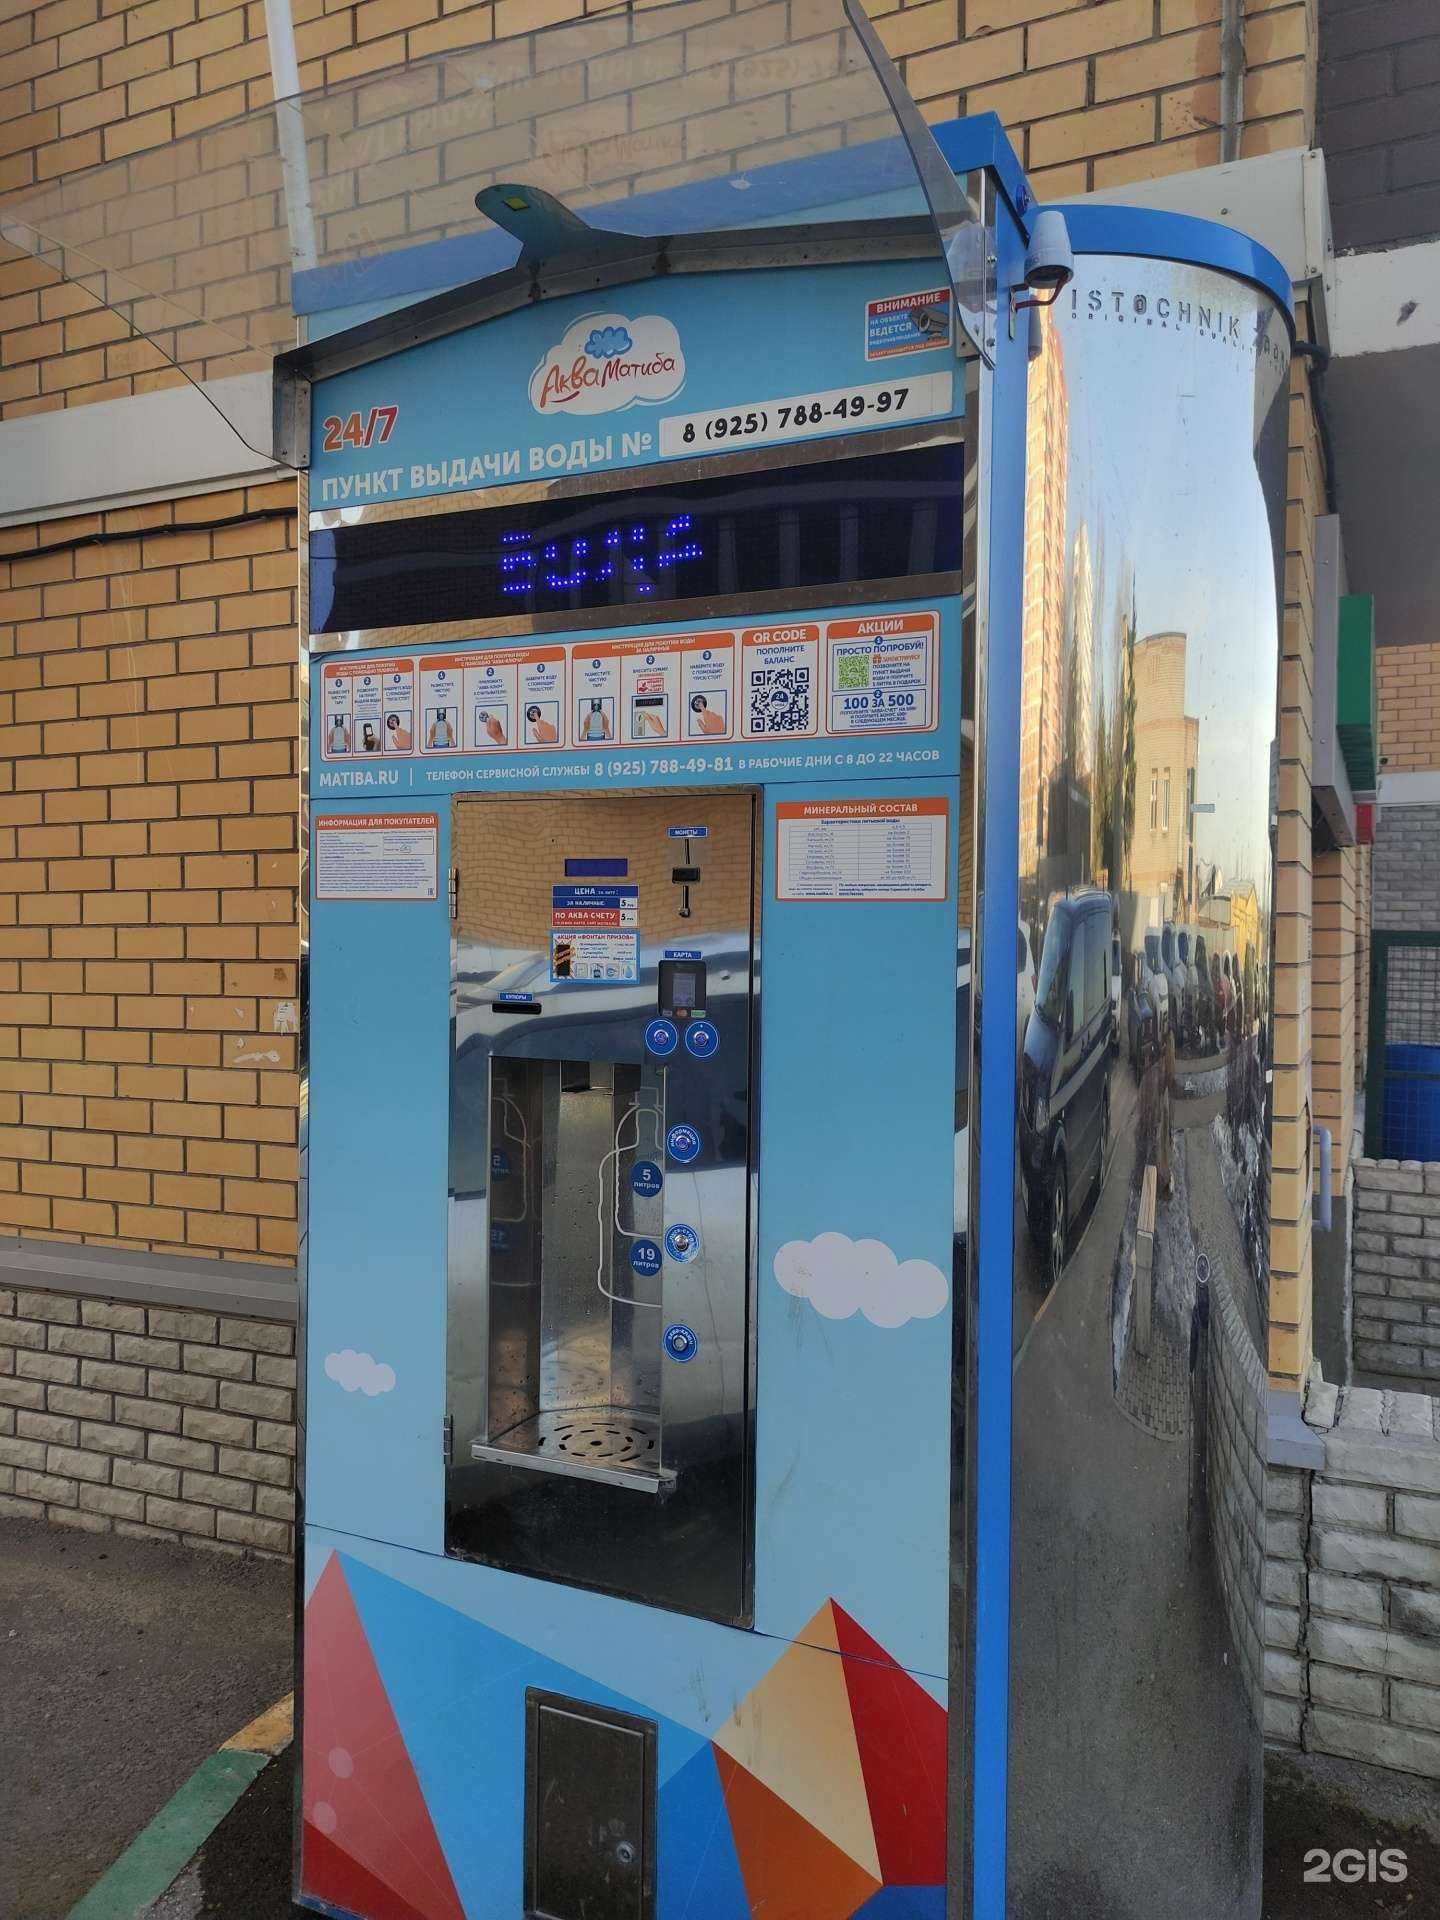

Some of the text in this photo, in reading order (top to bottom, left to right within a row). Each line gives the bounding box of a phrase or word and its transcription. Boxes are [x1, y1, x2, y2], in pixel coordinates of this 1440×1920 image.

[876, 292, 940, 313] ВНИМАНИЕ
[1072, 289, 1239, 339] ISTOCHNIK
[869, 322, 912, 337] ВЕДЕТСЯ
[540, 352, 675, 408] АкваМатиба
[683, 388, 909, 443] 8 (925) 788-49-97
[323, 405, 398, 452] 24/7
[322, 432, 652, 501] ПУНКТ ВЫДАЧИ ВОДЫ №
[857, 619, 904, 634] АКЦИИ
[753, 629, 806, 644] QR CODE
[756, 645, 805, 655] ПОПОЛНИТЕ
[836, 641, 924, 656] ПРОСТО ПОПРОБУЙ!
[764, 656, 795, 664] БАЛАНС
[844, 694, 914, 709] 100 ЗА 500
[426, 769, 473, 782] ТЕЛЕФОН
[476, 766, 539, 780] СЕРВИСНОЙ
[543, 765, 589, 778] СЛУЖБЫ
[595, 762, 603, 776] 8
[608, 759, 646, 778] (925)
[650, 757, 733, 775] 788-49-81
[748, 756, 802, 769] РАБОЧИЕ
[805, 755, 831, 767] ДНИ
[835, 754, 844, 766] С
[846, 754, 853, 765] 8
[856, 753, 875, 766] ДО
[878, 752, 893, 763] 22
[896, 750, 939, 762] ЧАСОВ
[320, 770, 399, 787] MATIBA.RU
[804, 803, 918, 815] МИНЕРАЛЬНЫЙ СОСТАВ
[318, 816, 435, 827] ИНФОРМАЦИЯ ДЛЯ ПОКУПАТЕЛЕЙ
[675, 828, 698, 836] МОНЕТЫ
[574, 887, 596, 895] ЦЕНА
[621, 899, 627, 907] 5
[620, 913, 626, 921] 5
[674, 951, 693, 959] КАРТА
[642, 1169, 651, 1181] 5
[638, 1247, 655, 1261] 19
[633, 1260, 659, 1269] литров
